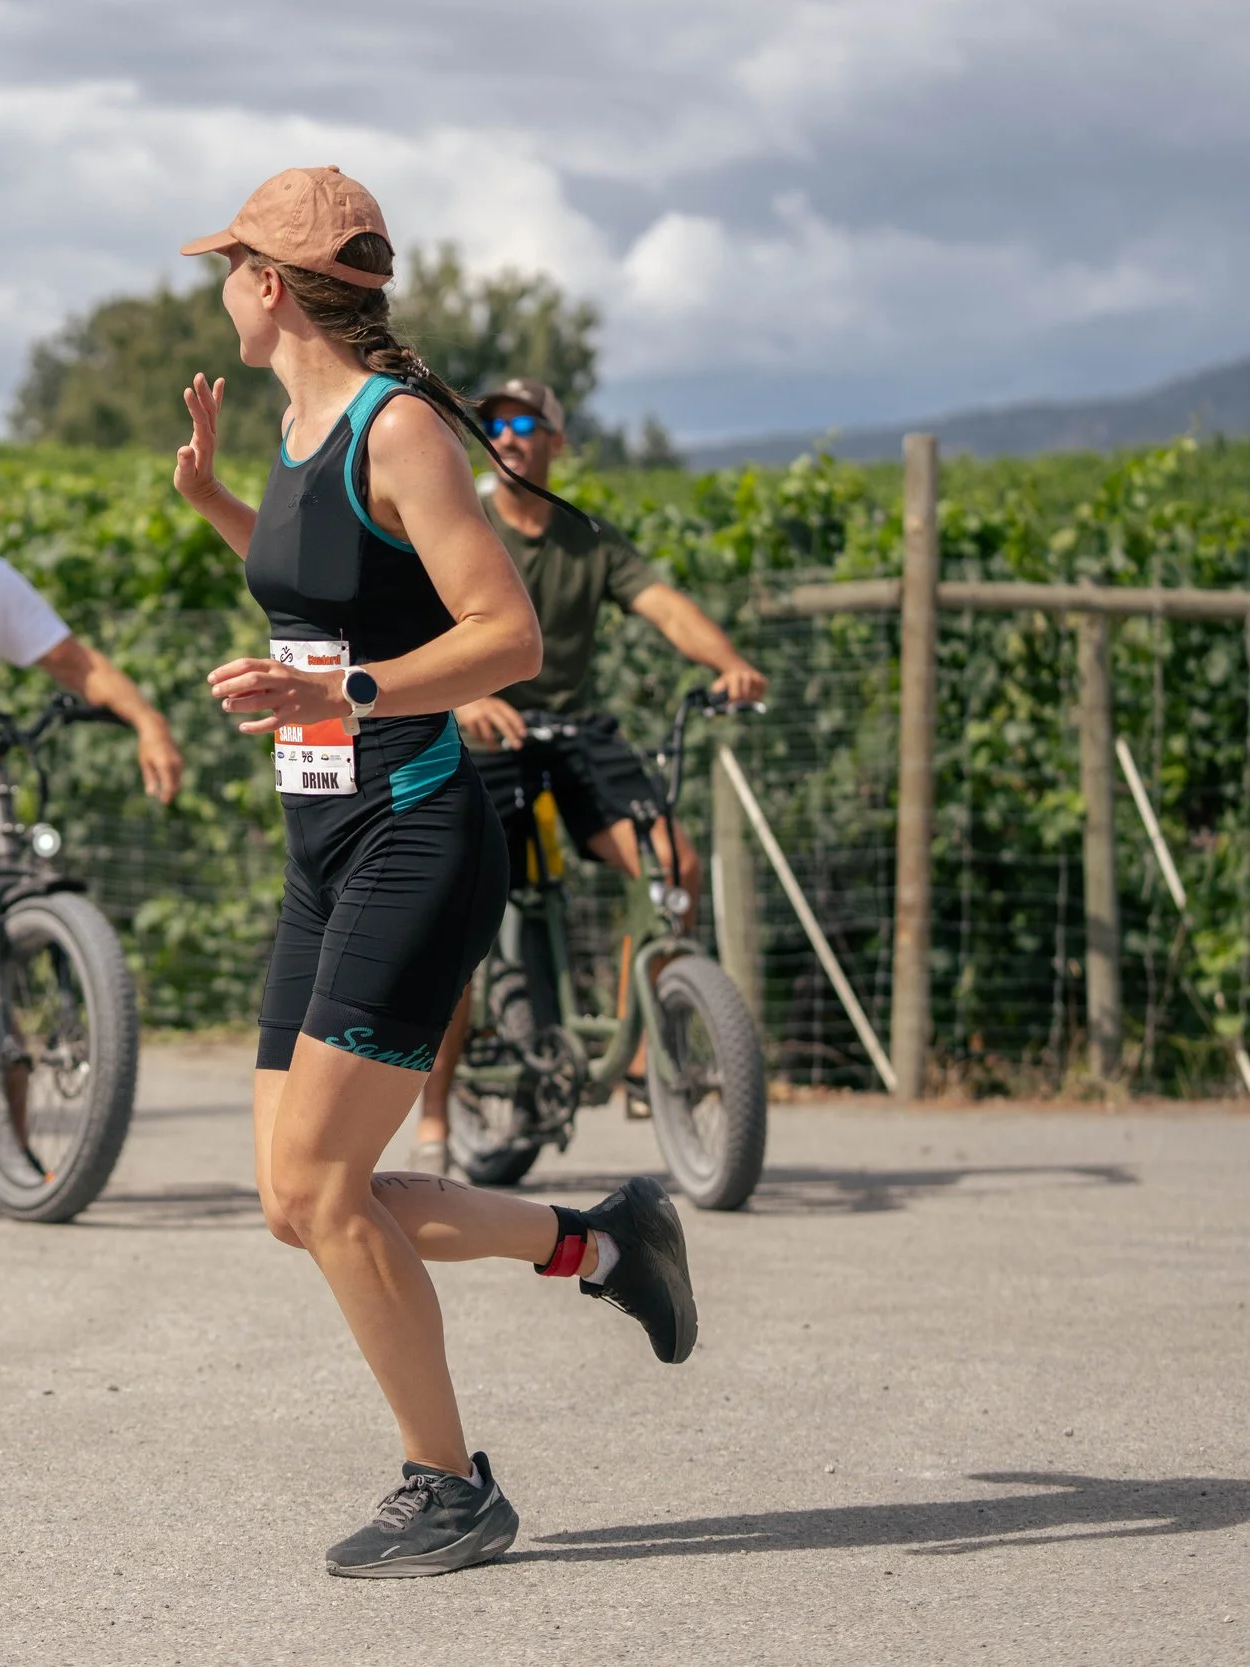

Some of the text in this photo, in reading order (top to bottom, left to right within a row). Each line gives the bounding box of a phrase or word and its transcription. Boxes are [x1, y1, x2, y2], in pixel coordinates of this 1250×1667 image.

[279, 725, 303, 743] SARAH
[302, 755, 313, 763] 70
[302, 772, 339, 789] DRINK
[325, 1027, 434, 1071] Santic
